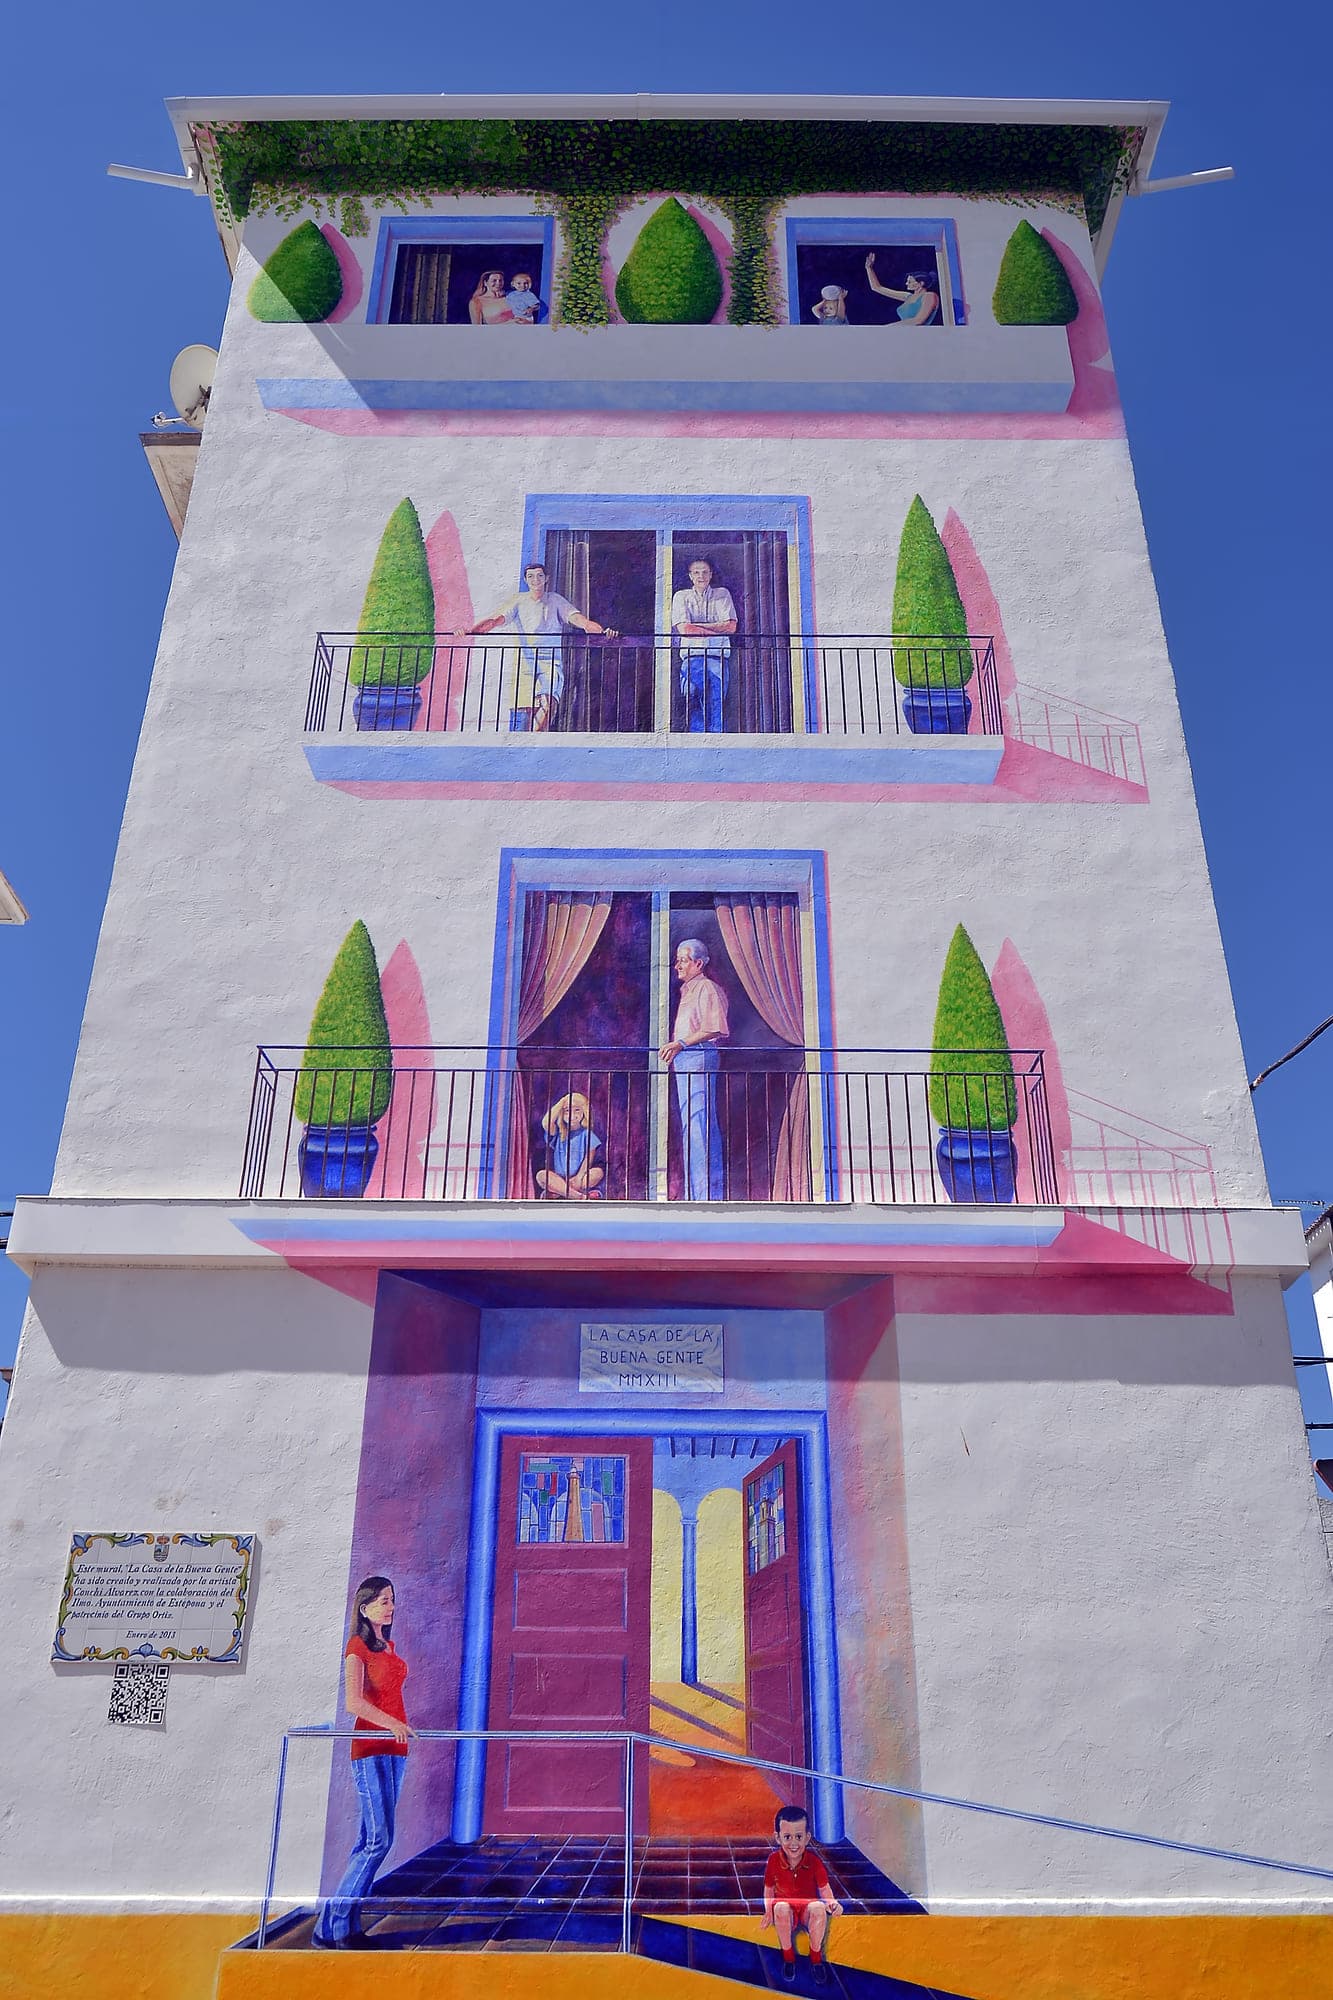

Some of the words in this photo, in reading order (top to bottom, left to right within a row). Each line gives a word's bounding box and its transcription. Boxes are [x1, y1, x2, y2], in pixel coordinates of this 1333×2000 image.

[590, 1329, 609, 1342] LA
[617, 1329, 657, 1342] CASA
[666, 1329, 683, 1342] DE
[694, 1329, 713, 1342] LA
[600, 1350, 648, 1364] BUENA
[657, 1350, 704, 1365] GENTE
[619, 1373, 677, 1387] MMXIII
[76, 1564, 95, 1573] Este
[142, 1564, 162, 1573] Casa
[164, 1564, 174, 1573] de
[175, 1564, 184, 1573] la
[184, 1564, 212, 1573] Buena
[74, 1576, 86, 1585] ha
[87, 1576, 105, 1585] sido
[106, 1575, 134, 1585] creado
[142, 1576, 181, 1585] realizado
[182, 1578, 197, 1586] por
[198, 1576, 207, 1585] la
[208, 1577, 237, 1585] artista
[73, 1587, 103, 1596] Conchi
[156, 1587, 164, 1596] la
[166, 1587, 218, 1596] colaboración
[220, 1587, 234, 1596] del
[71, 1598, 93, 1607] Ilmo.
[93, 1598, 154, 1608] Ayuntamiento
[156, 1598, 166, 1607] de
[167, 1598, 206, 1608] Estepona
[208, 1601, 214, 1609] y
[216, 1599, 225, 1607] el
[71, 1610, 109, 1619] patrocinio
[111, 1610, 124, 1618] del
[126, 1610, 151, 1620] Grupo
[125, 1630, 147, 1639] Enero
[149, 1630, 158, 1639] de
[159, 1631, 176, 1639] 2013
